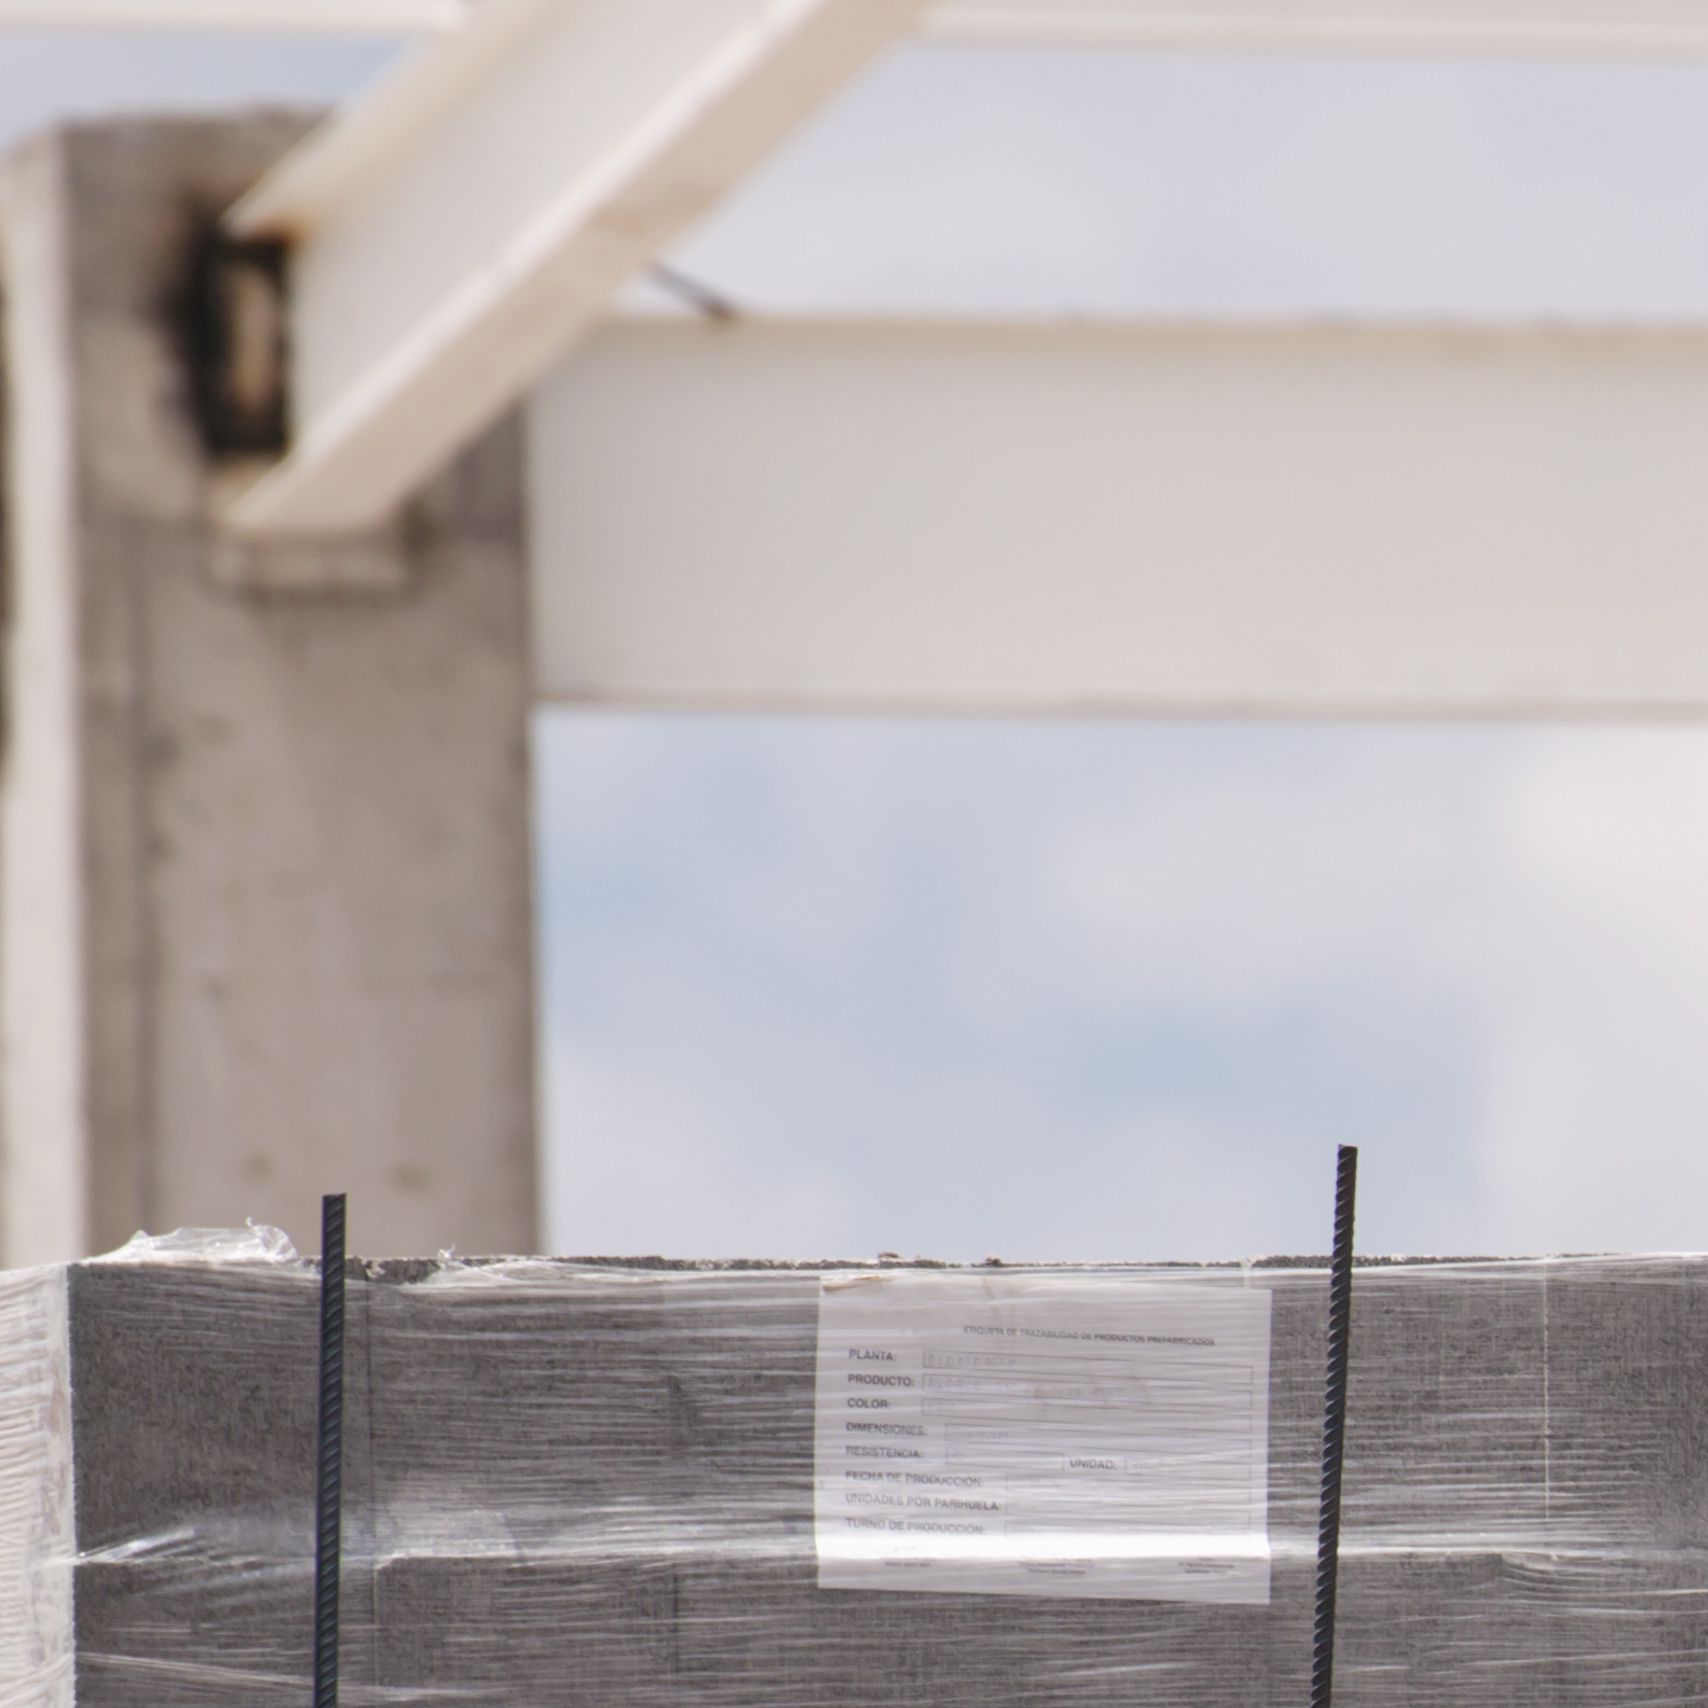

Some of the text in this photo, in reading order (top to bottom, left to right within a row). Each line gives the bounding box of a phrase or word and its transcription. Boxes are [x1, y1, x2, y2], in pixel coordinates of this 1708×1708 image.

[963, 1325, 1216, 1346] ETIQUETA DE TRAZABILIDAD DE PRODUCTOS PREFABRICADOS
[848, 1349, 896, 1361] PLANTA:
[847, 1374, 914, 1387] PRODUCTO:
[845, 1471, 884, 1481] FECHA
[887, 1471, 902, 1482] DE
[845, 1492, 1001, 1511] UNIDADES POR PARIHUELA:
[845, 1517, 885, 1529] TURNO
[889, 1519, 904, 1531] DE
